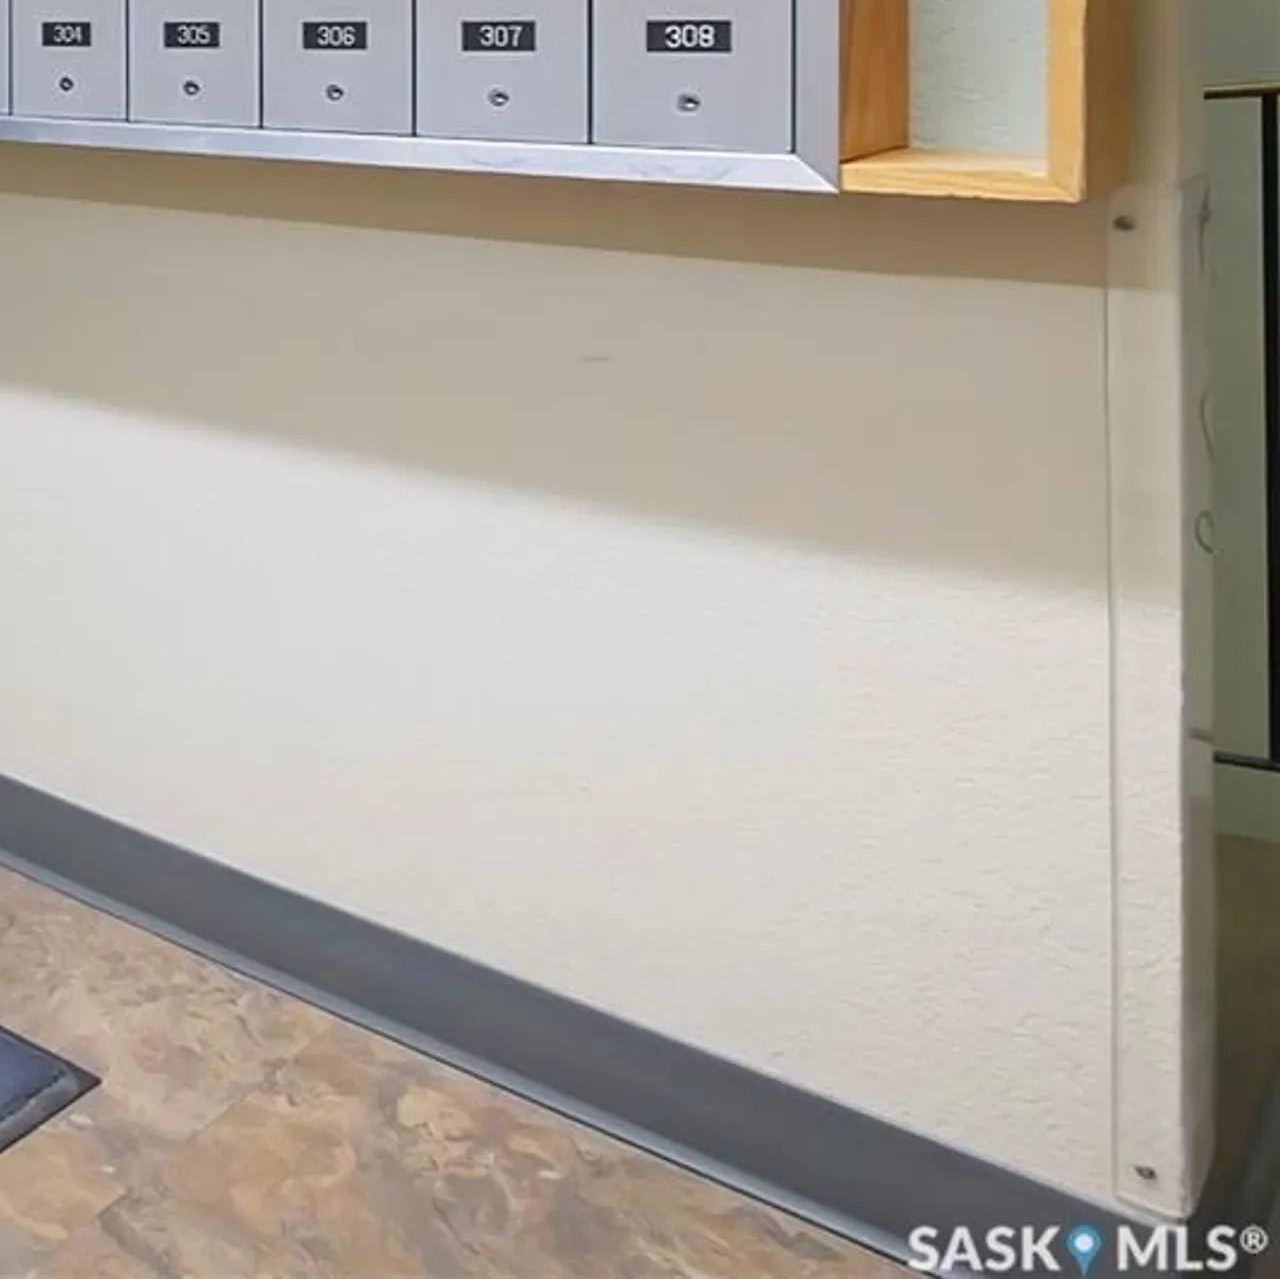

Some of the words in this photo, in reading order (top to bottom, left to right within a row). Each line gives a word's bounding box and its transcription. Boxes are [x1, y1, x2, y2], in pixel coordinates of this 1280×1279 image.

[176, 24, 211, 45] 305
[316, 25, 356, 47] 306
[479, 25, 523, 48] 307
[664, 24, 716, 49] 308
